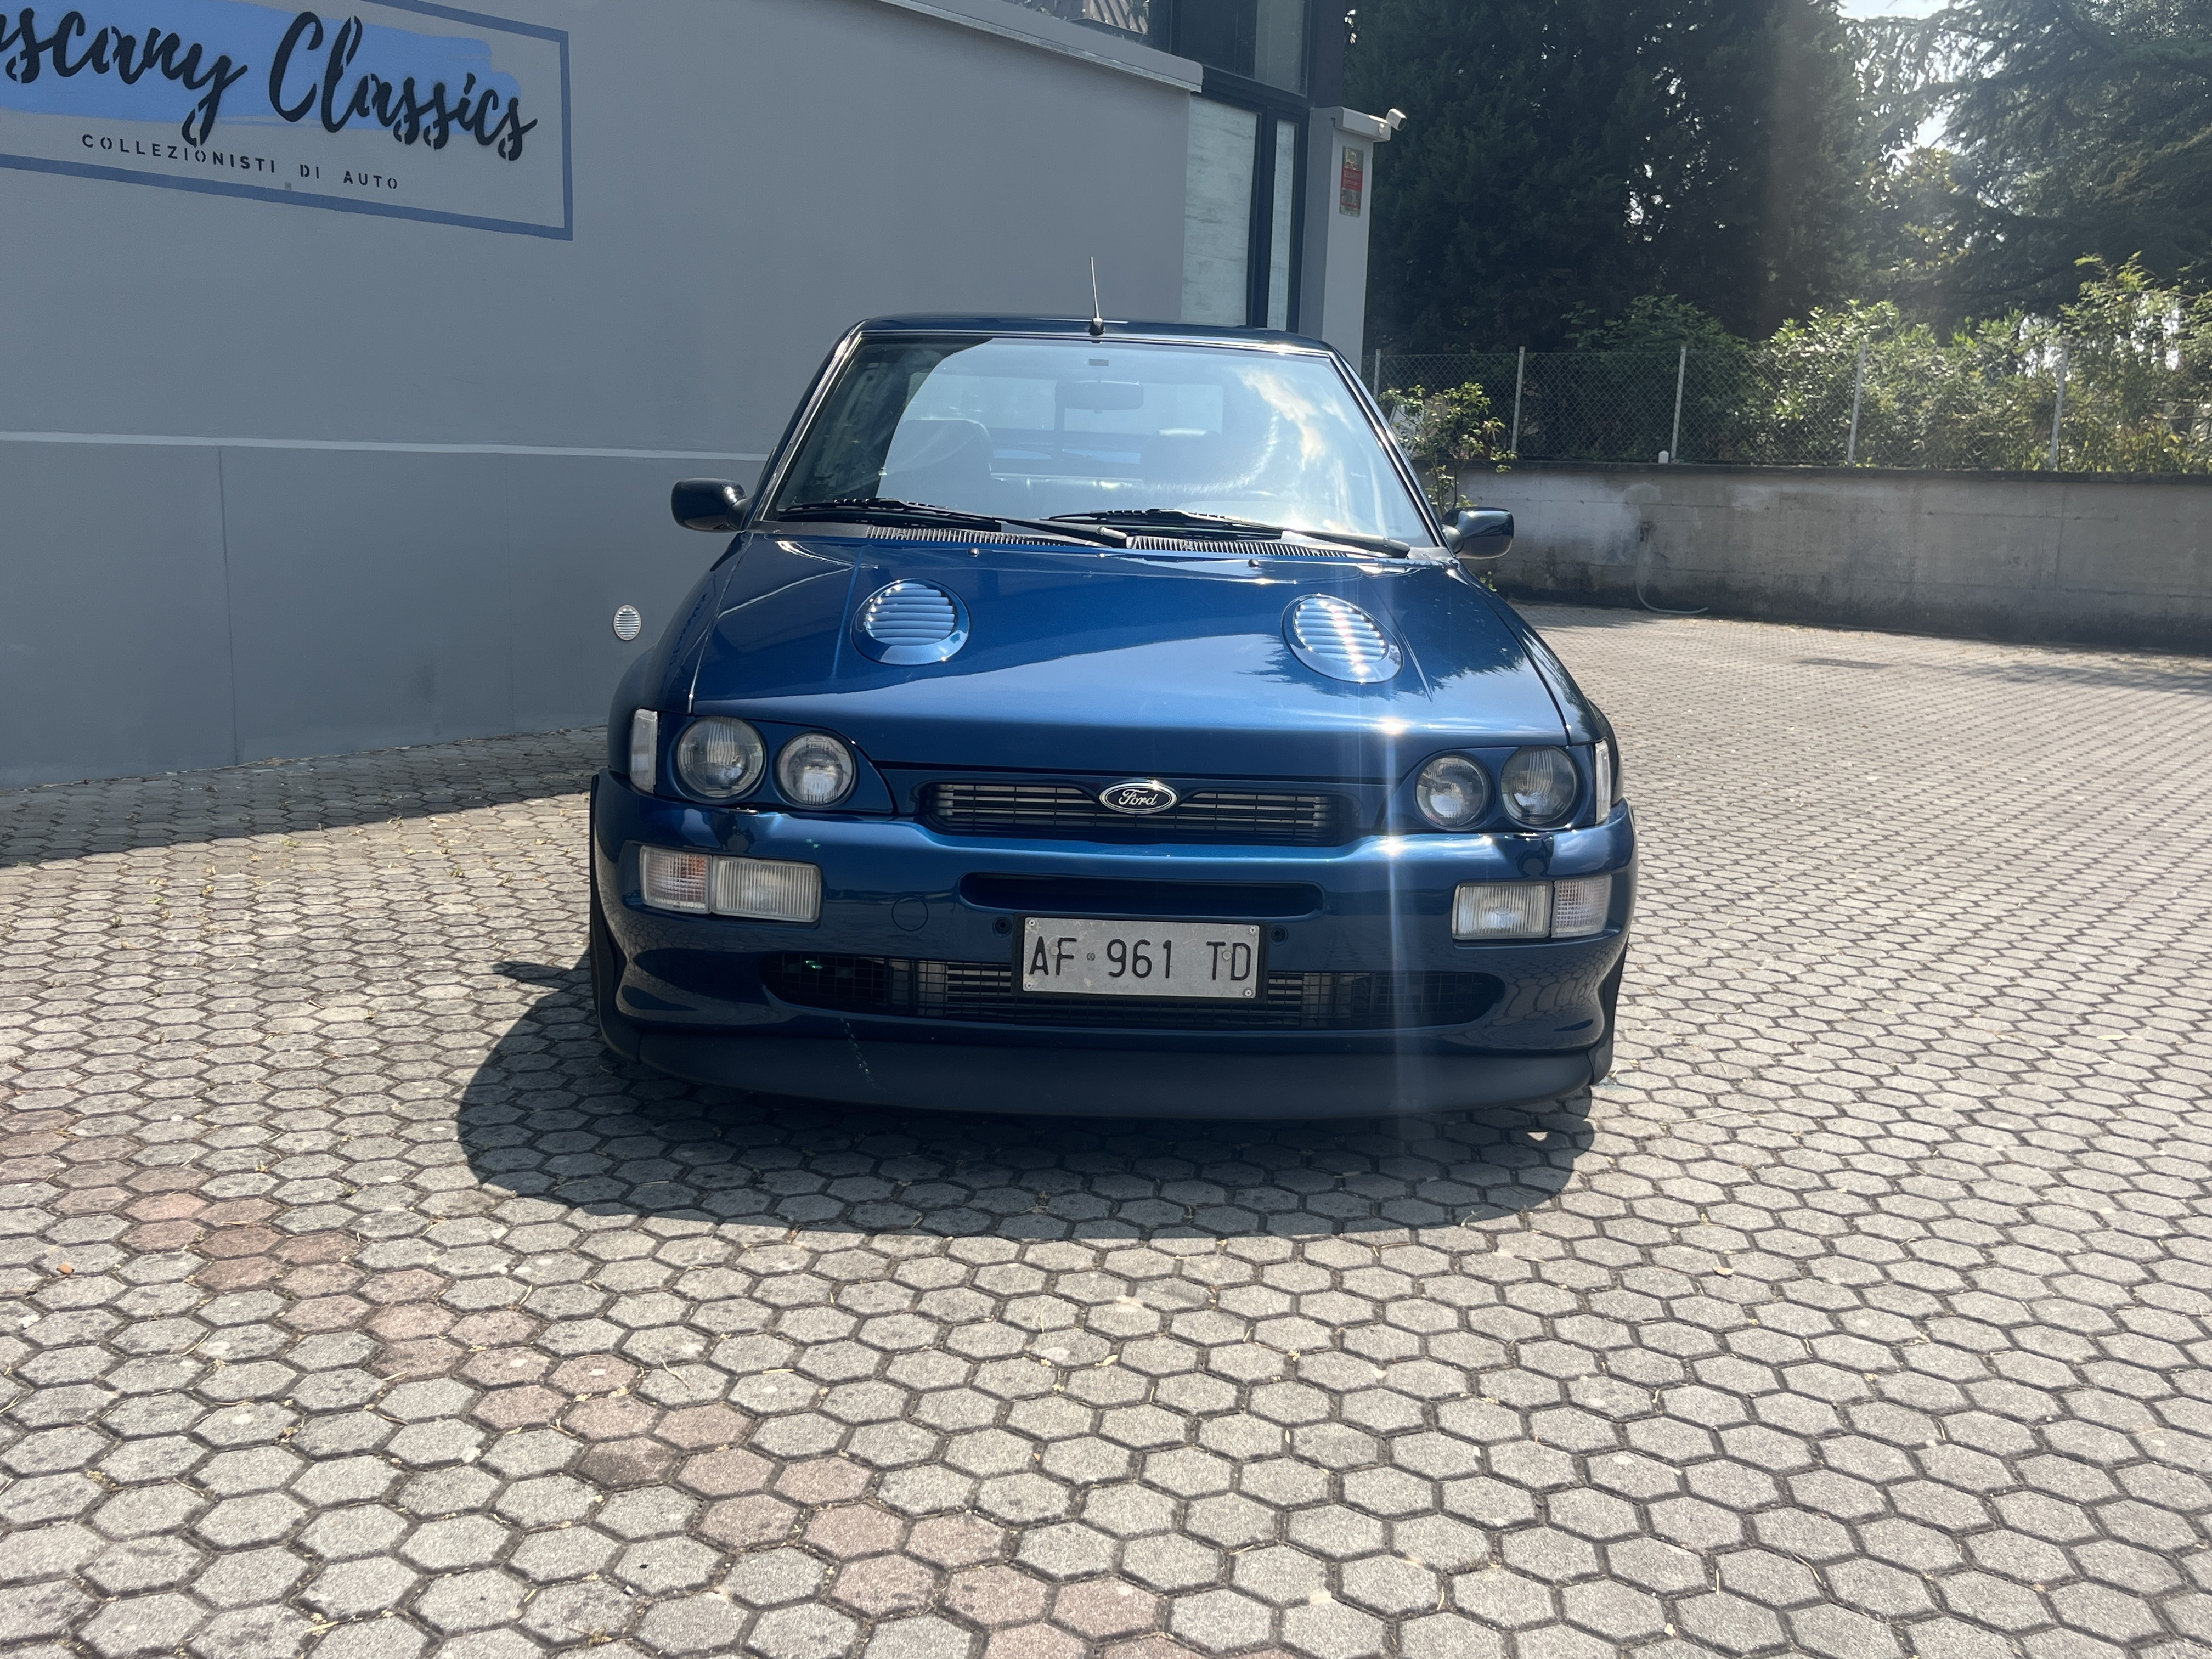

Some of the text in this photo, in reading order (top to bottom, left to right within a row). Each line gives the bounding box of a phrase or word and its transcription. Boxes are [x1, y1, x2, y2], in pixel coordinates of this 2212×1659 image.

[269, 11, 538, 161] Classics
[82, 134, 398, 190] COLLEZIONISTI DI AUTO
[1118, 789, 1159, 805] Ford
[1029, 936, 1252, 981] AF 961 TD
